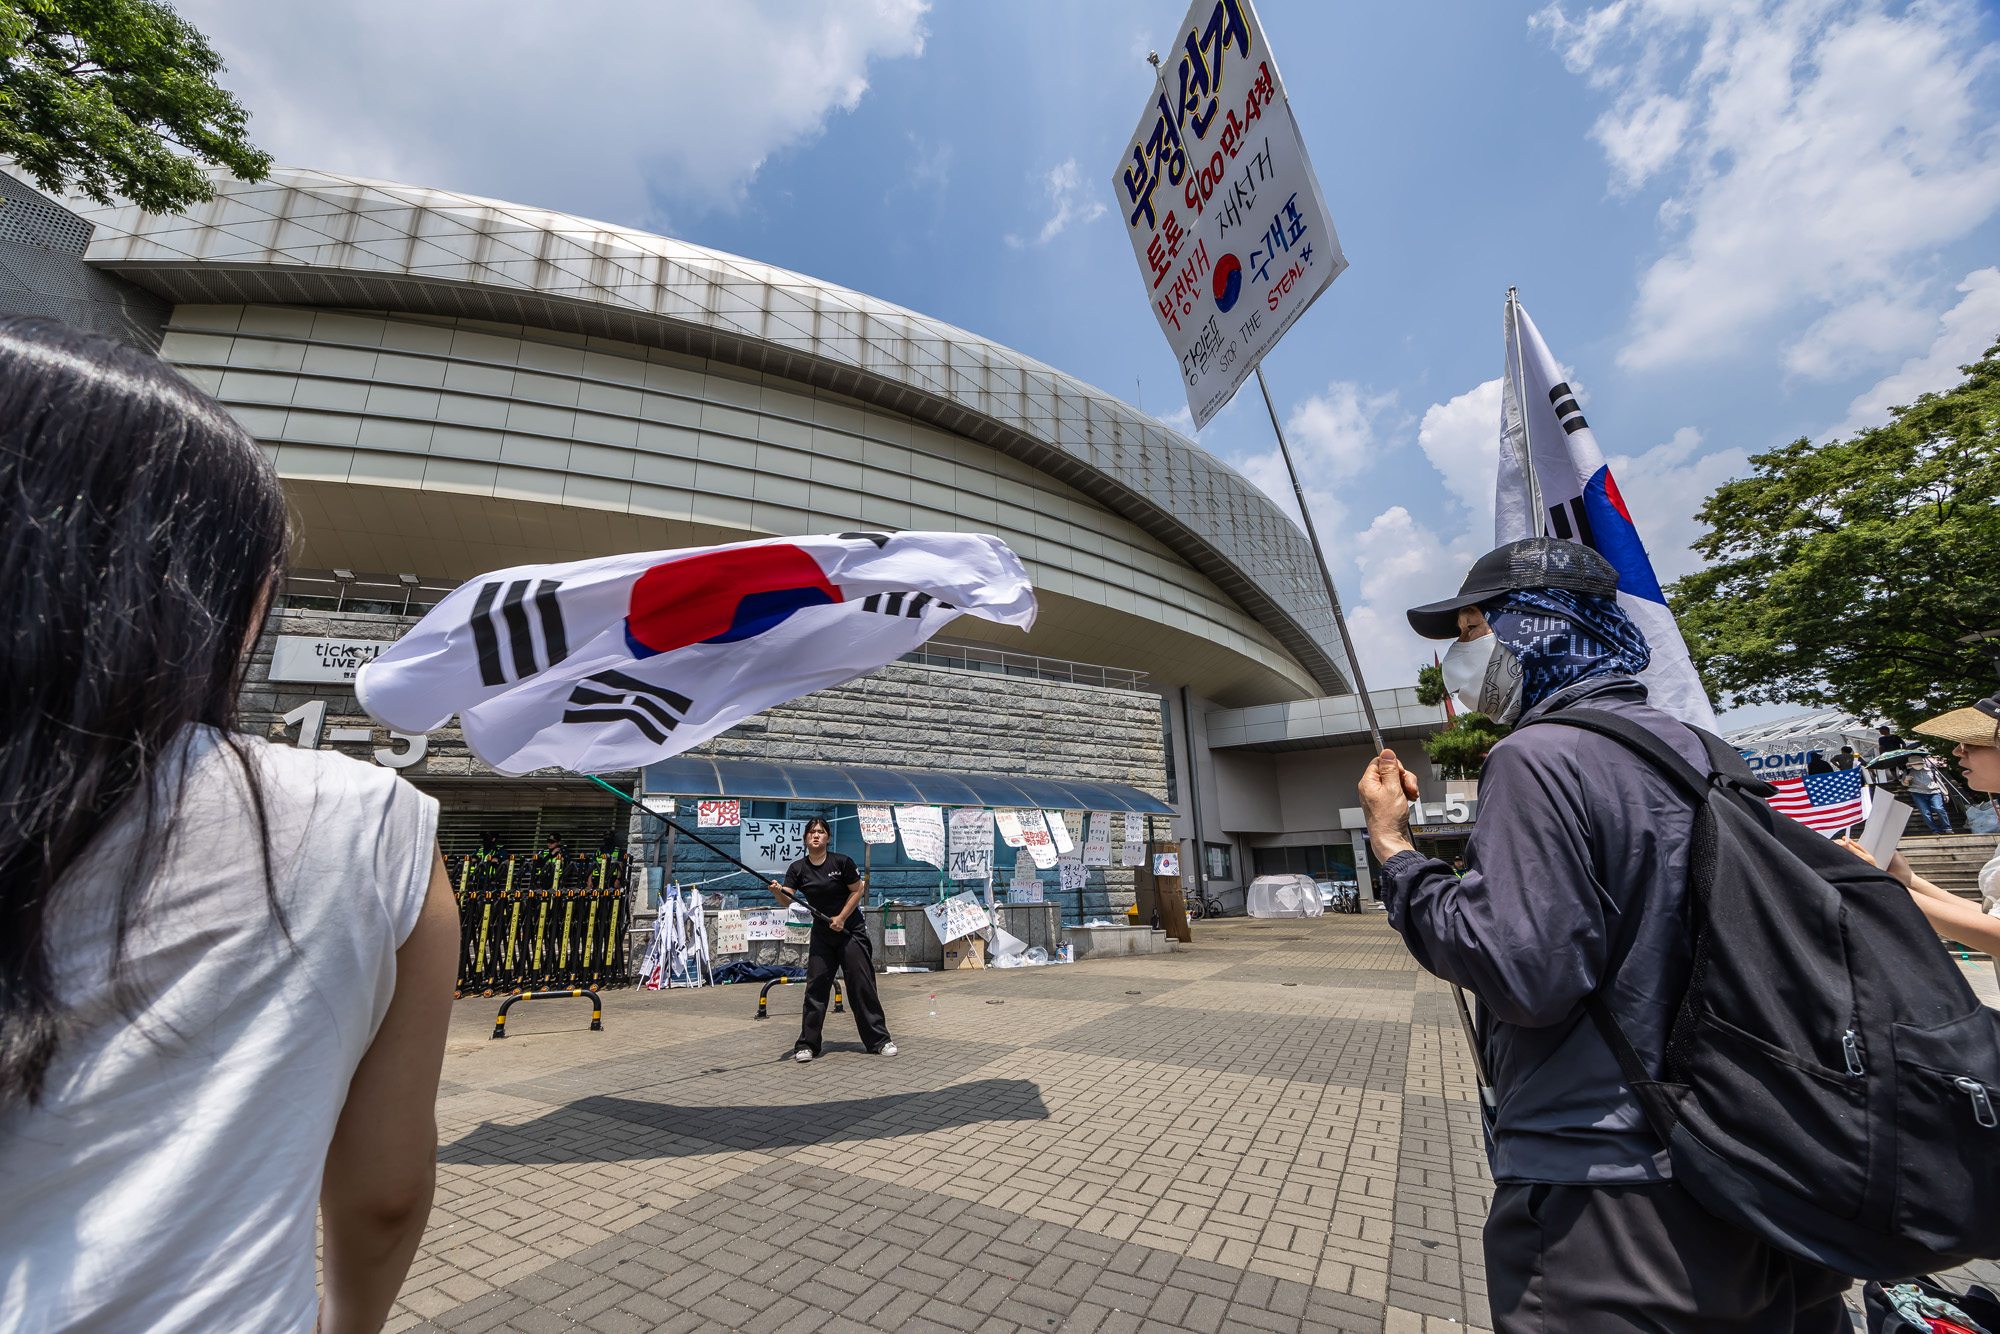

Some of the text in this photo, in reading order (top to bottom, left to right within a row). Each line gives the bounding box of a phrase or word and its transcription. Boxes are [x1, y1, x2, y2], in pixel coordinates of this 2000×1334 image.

[1123, 0, 1251, 231] 부정선거
[1215, 137, 1274, 240] 재선거
[1251, 192, 1307, 284] 수개표
[1158, 238, 1211, 331] 부정선거
[1182, 314, 1225, 386] 당일투표
[1220, 340, 1237, 373] STOP
[1239, 309, 1262, 344] THE
[315, 643, 380, 658] ticketL
[322, 658, 356, 668] LIVE
[698, 800, 739, 816] 선거소청
[717, 813, 740, 826] D-8
[1408, 793, 1470, 825] 1-5
[745, 822, 808, 844] 부정선
[760, 843, 806, 862] 재선거
